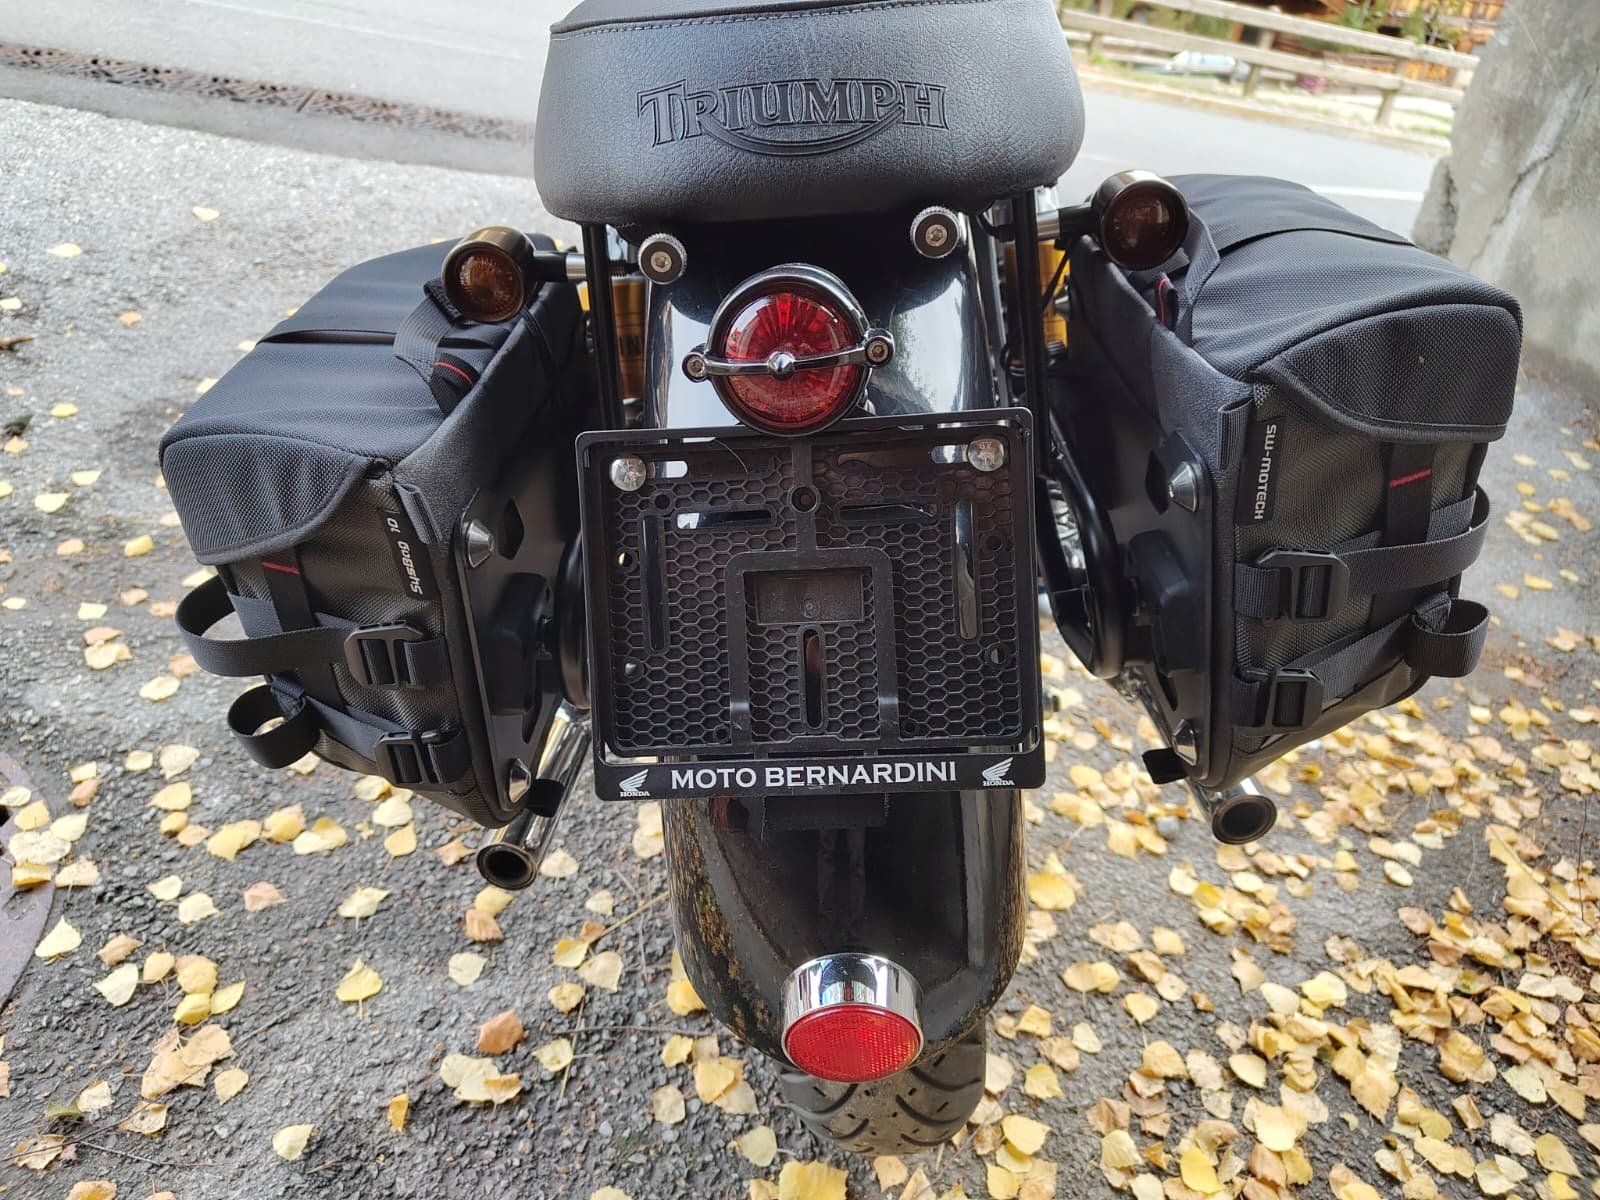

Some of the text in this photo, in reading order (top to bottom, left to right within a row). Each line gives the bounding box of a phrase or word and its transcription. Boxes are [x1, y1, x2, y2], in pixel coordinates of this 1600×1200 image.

[637, 78, 949, 154] TRIUMPH
[1253, 424, 1277, 520] SW-MOTECH
[386, 517, 424, 595] SysBag 10
[619, 790, 650, 798] HONDA
[671, 761, 956, 790] MOTO BERNARDINI
[982, 779, 1015, 788] HONDA
